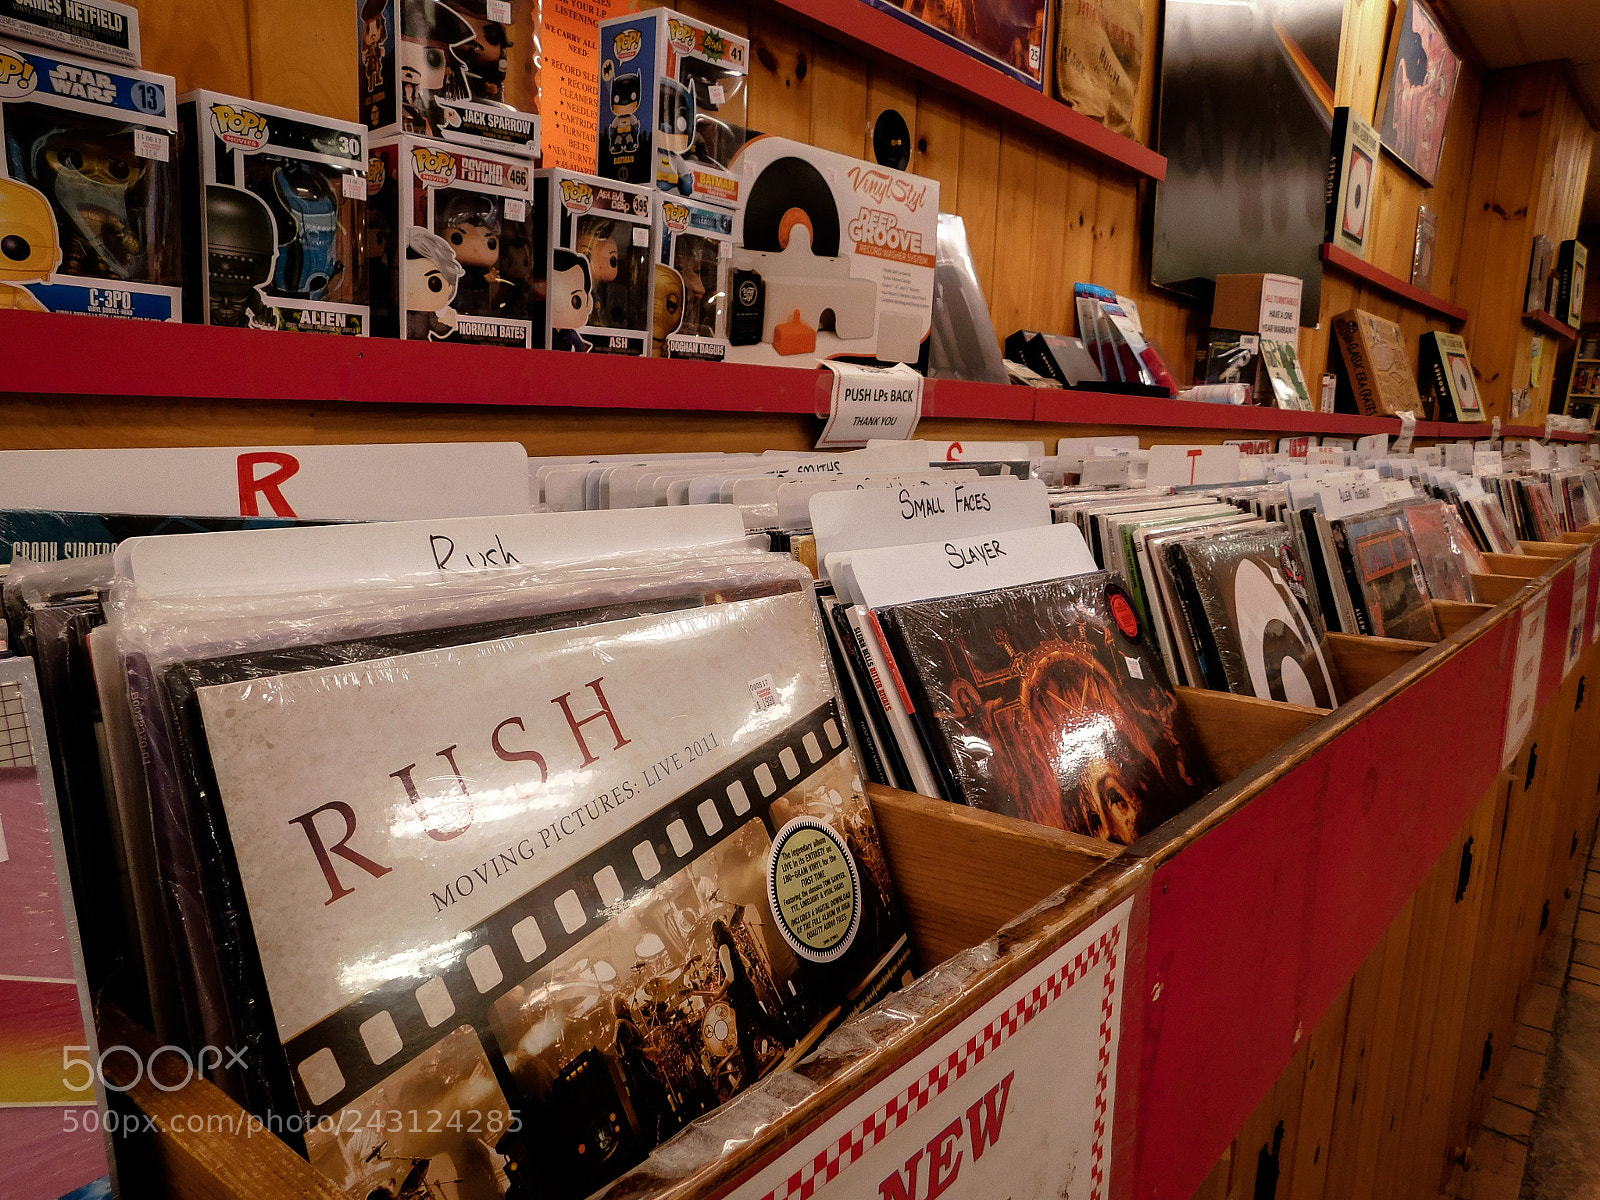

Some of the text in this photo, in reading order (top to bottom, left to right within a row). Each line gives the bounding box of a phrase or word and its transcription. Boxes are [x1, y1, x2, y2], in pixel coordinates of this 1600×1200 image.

[66, 0, 122, 32] HETFIELD
[556, 4, 598, 28] LISTENING
[544, 22, 597, 50] WE CARRY ALL
[614, 30, 642, 54] POP!
[668, 18, 696, 46] POP!
[730, 48, 742, 60] 41
[1030, 48, 1039, 62] 25
[49, 64, 117, 92] STAR
[552, 59, 581, 77] RECORD
[50, 76, 118, 104] WARS
[138, 84, 158, 110] 13
[568, 78, 598, 95] RECORD
[208, 102, 268, 139] POP!
[462, 110, 486, 126] JACK
[488, 114, 531, 134] SPARROW
[226, 136, 258, 148] MOVIES
[338, 136, 360, 156] 30
[552, 144, 566, 156] NEW
[568, 138, 590, 152] BELTS
[410, 147, 456, 176] POP!
[462, 158, 504, 186] PSYCHO
[510, 170, 526, 186] 466
[700, 172, 735, 191] BATMAN
[560, 179, 593, 204] POP!
[664, 201, 690, 224] POP!
[859, 206, 898, 230] DEEP
[848, 218, 922, 254] GROOVE
[89, 288, 132, 310] C-3PO
[300, 310, 346, 328] ALIEN
[459, 322, 498, 338] NORMAN
[500, 324, 526, 340] BATES
[608, 336, 628, 350] ASH
[1346, 342, 1378, 417] CLASSIC ERA CRATES
[844, 388, 914, 402] PUSH LPs BACK
[852, 416, 898, 426] THANK YOU
[1186, 449, 1202, 486] T
[236, 451, 300, 518] R
[899, 485, 992, 520] SMALL FACES
[944, 540, 1008, 570] SLAYER
[854, 626, 892, 712] SLEIGH BELLS BITTER RIVALS
[288, 676, 632, 906] RUSH
[430, 732, 720, 913] MOVING PICTURES: LIVE 2011
[782, 862, 793, 872] LIVE
[800, 870, 826, 888] FIRST TIME
[808, 860, 822, 874] VINYL
[878, 1070, 1015, 1200] NEW
